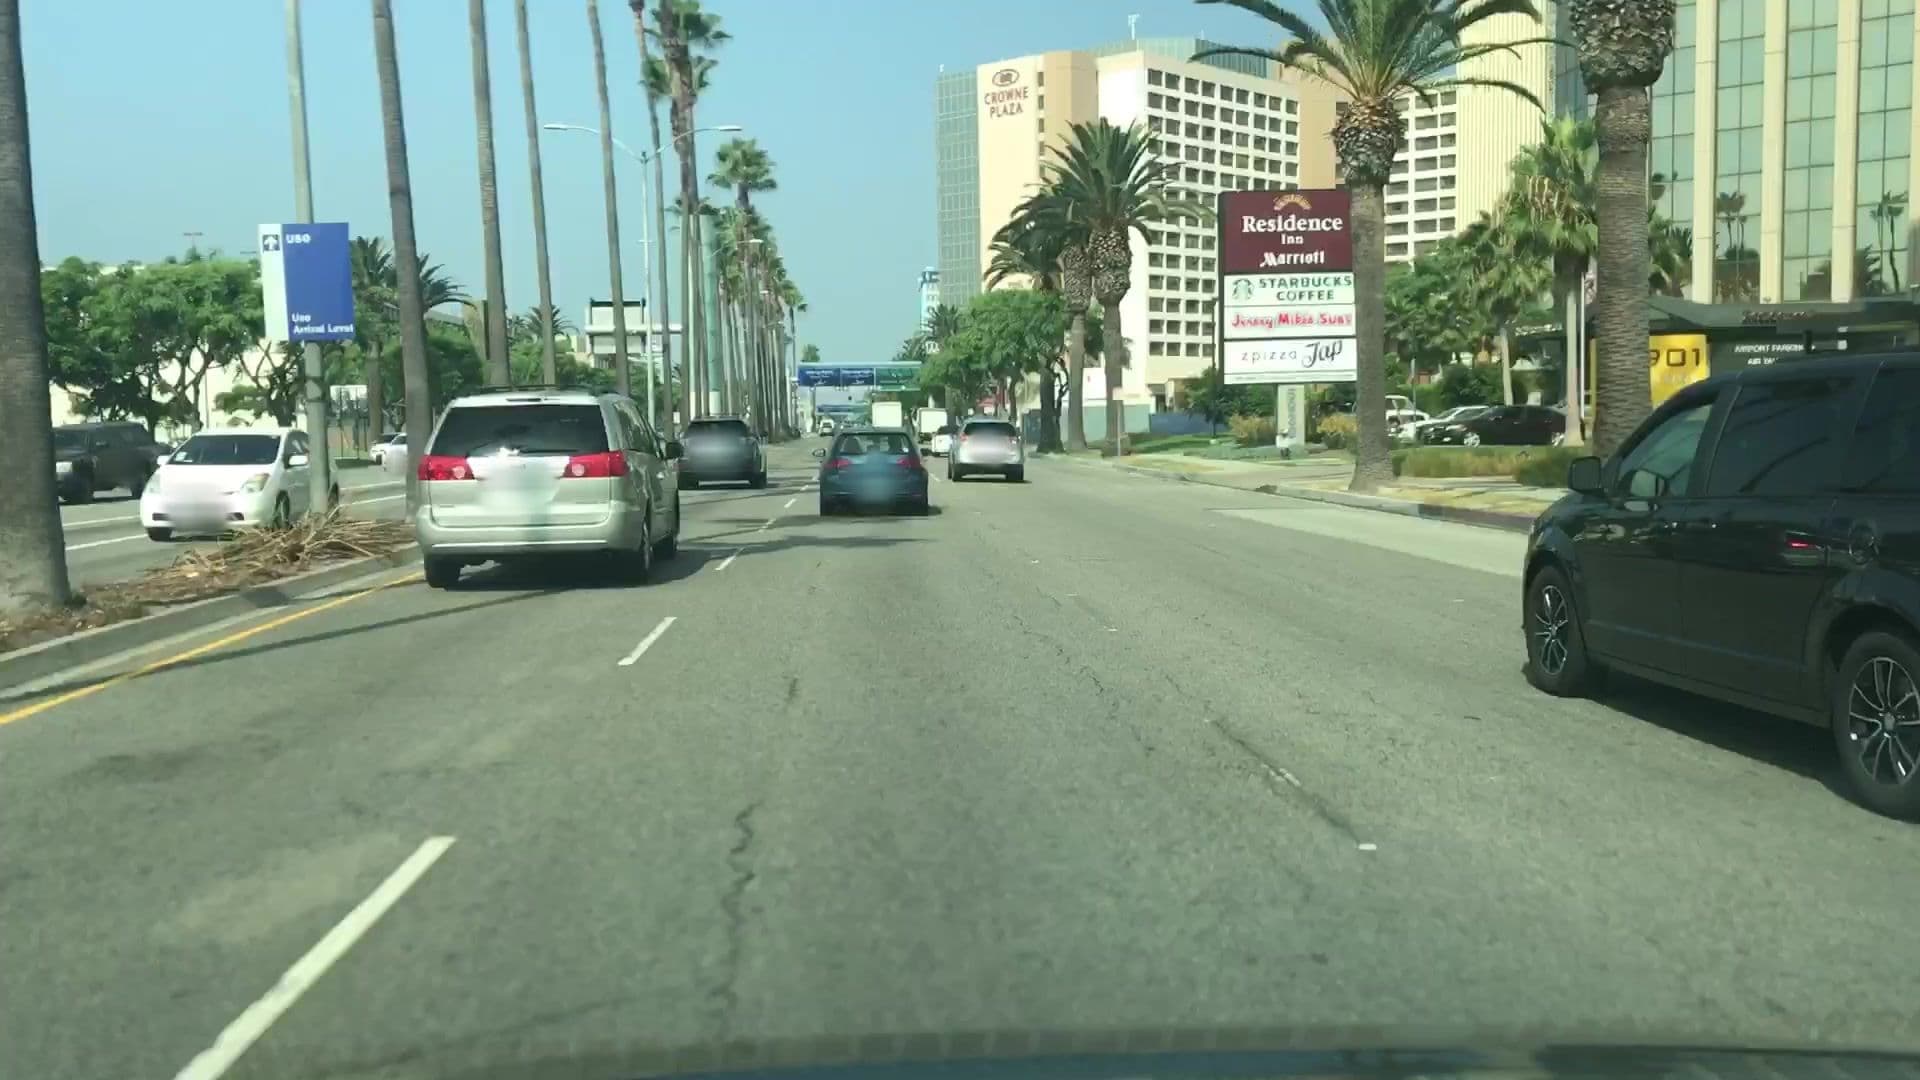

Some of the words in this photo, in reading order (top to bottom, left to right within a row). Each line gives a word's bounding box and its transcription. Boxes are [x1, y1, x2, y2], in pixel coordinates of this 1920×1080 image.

[984, 86, 1028, 104] CROWNE
[990, 103, 1023, 118] PLAZA
[1241, 214, 1343, 233] Residence
[1281, 233, 1304, 245] Inn
[1259, 250, 1325, 268] Marriott
[1260, 275, 1352, 289] STARBUCKS
[1276, 290, 1334, 301] COFFEE
